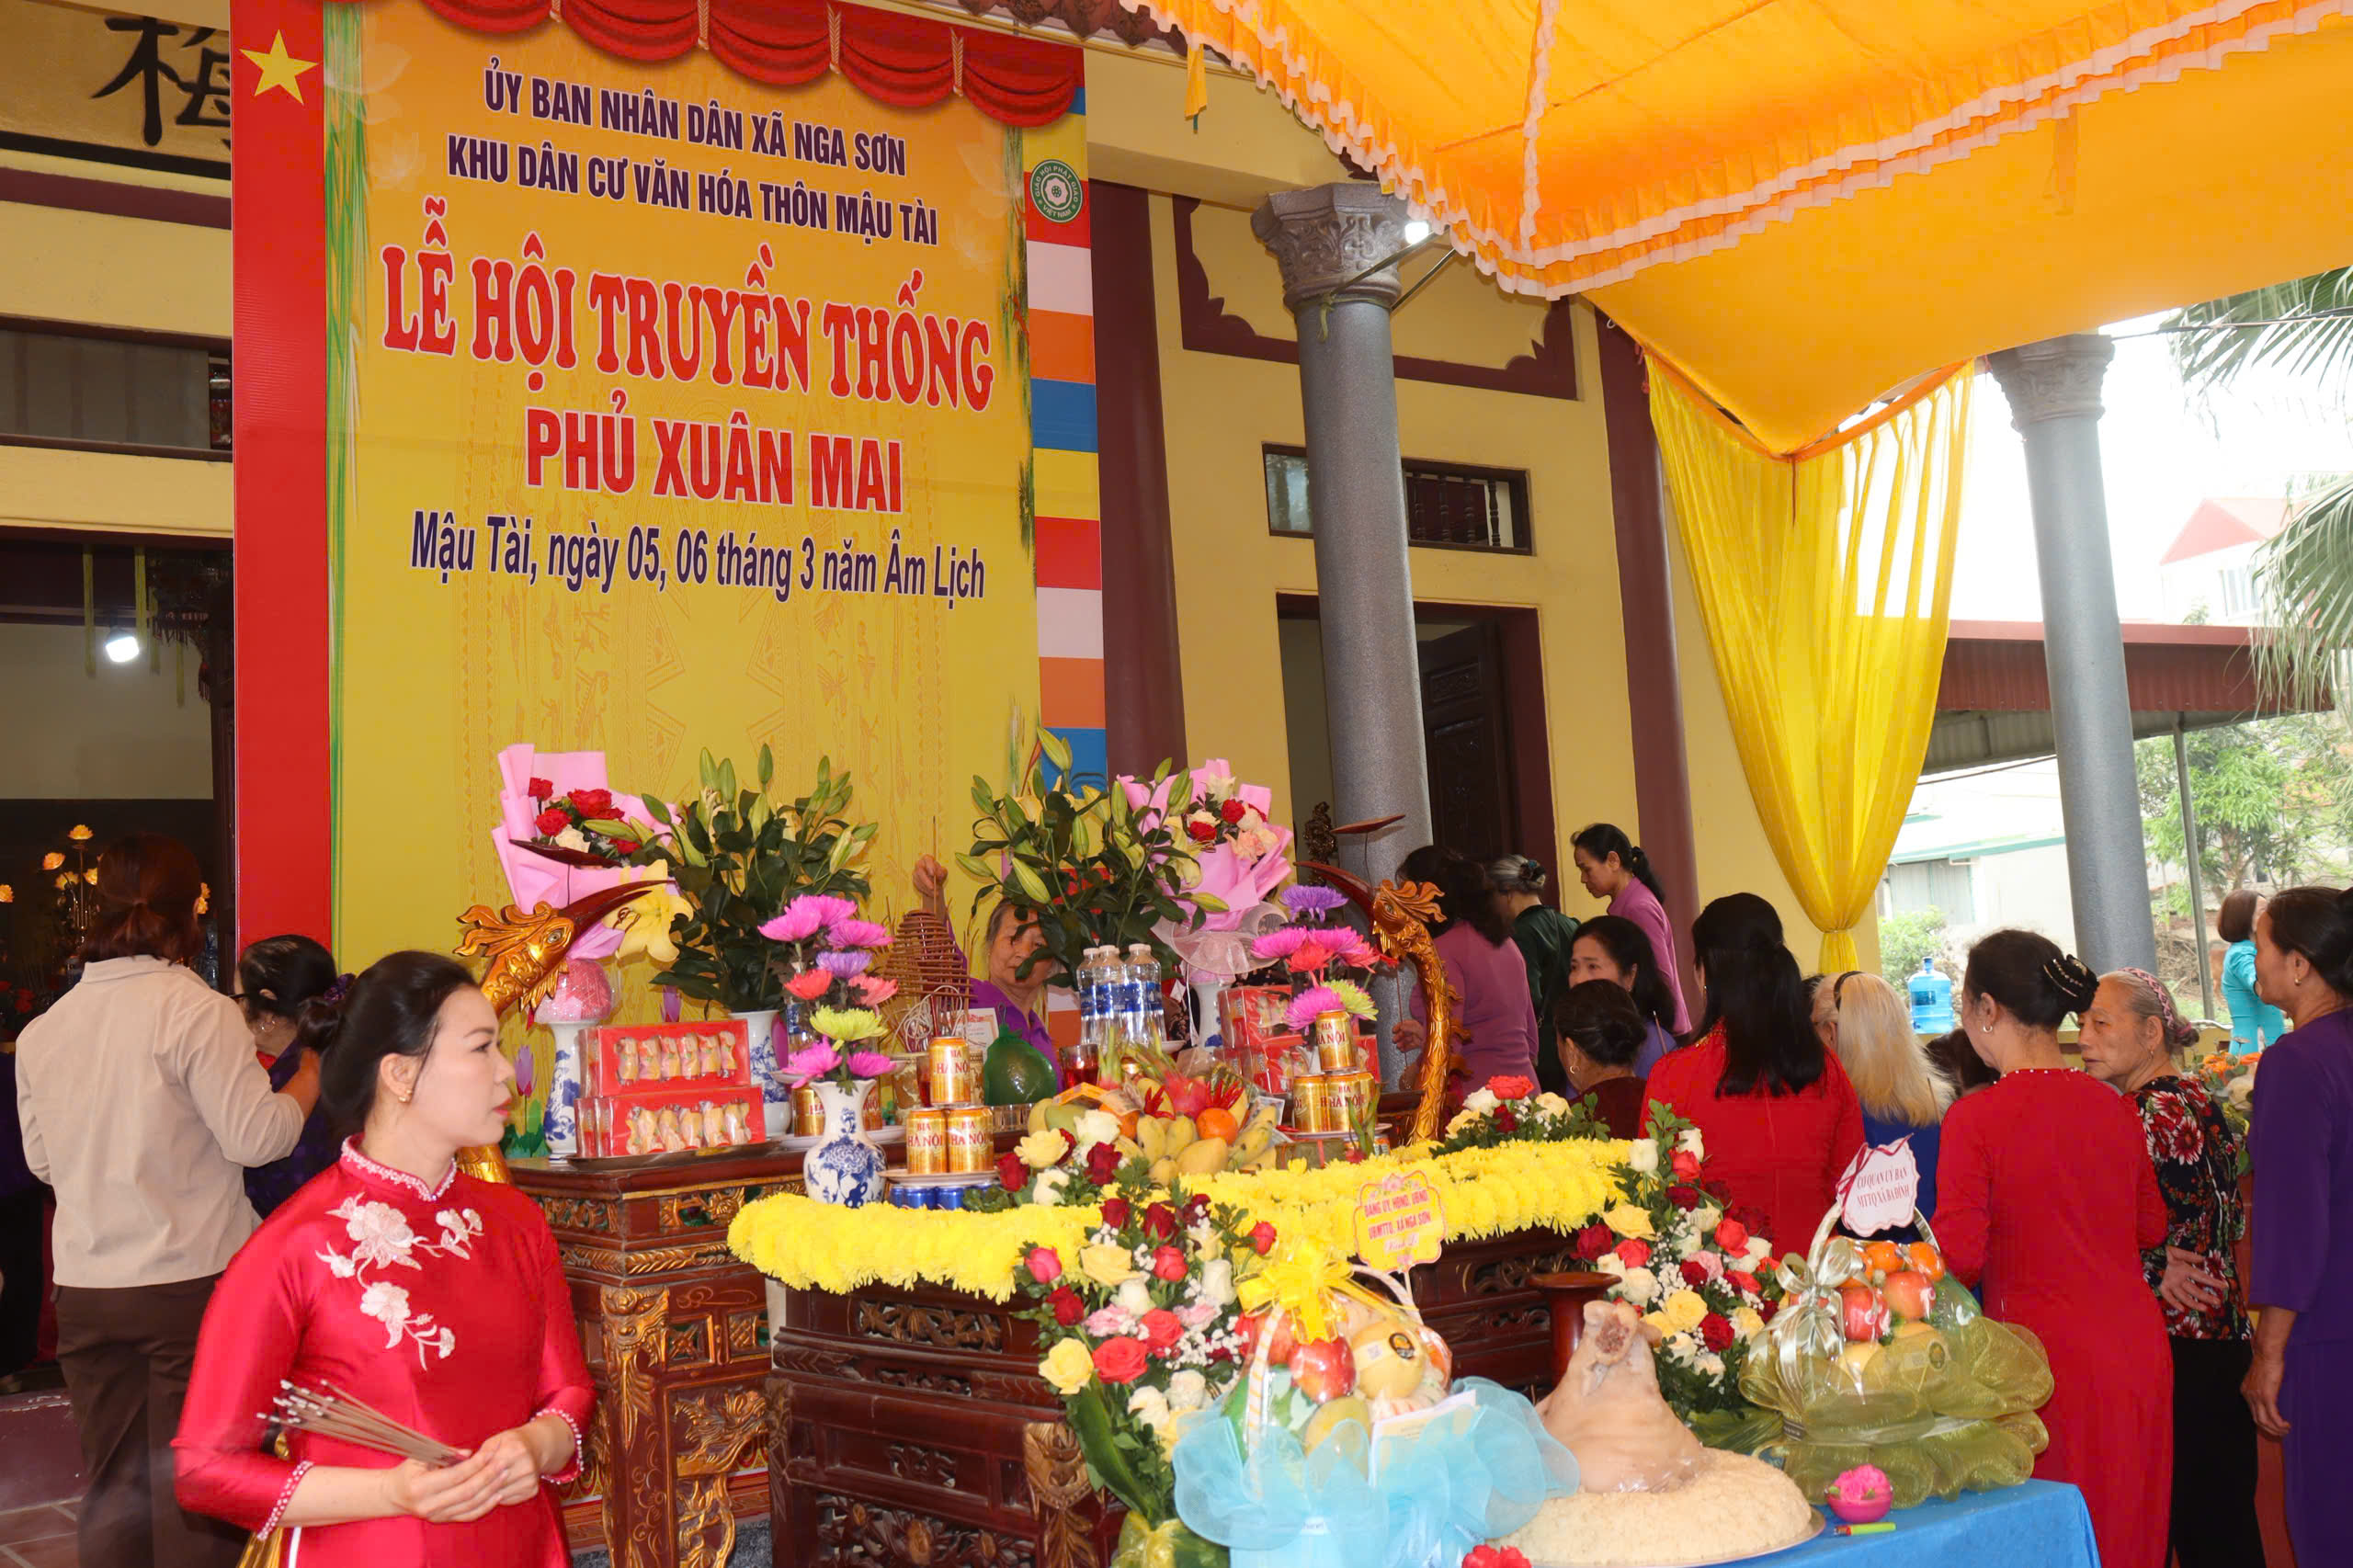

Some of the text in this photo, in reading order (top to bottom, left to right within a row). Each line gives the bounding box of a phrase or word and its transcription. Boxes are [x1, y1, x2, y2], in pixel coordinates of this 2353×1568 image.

[484, 56, 905, 176] ỦY BAN NHÂN DÂN XÃ NGA SƠN
[449, 135, 938, 245] KHU DÂN CƯ VĂN HÓA THÔN MẬU TÀI
[382, 197, 994, 412] LỄ HỘI TRUYỀN THỐNG
[528, 389, 902, 513] PHỦ XUÂN MAI
[411, 510, 984, 609] Mậu Tài, ngày 05, 06 tháng 3 năm Âm Lịch
